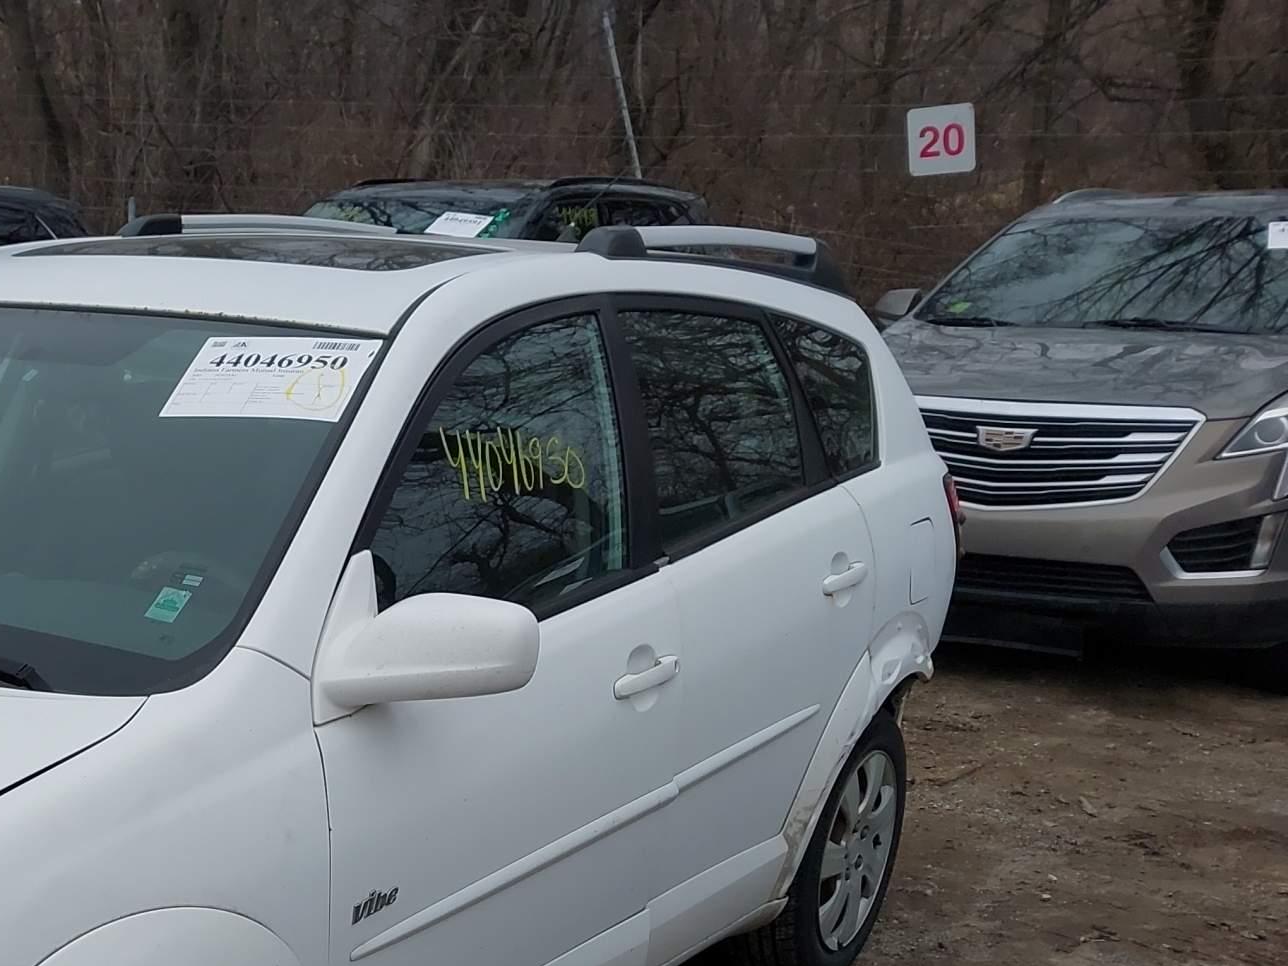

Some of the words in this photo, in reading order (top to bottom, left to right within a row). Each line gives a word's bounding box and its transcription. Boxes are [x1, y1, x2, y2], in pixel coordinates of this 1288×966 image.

[919, 123, 965, 158] 20
[209, 353, 349, 371] 44046950
[439, 426, 585, 502] 44046950
